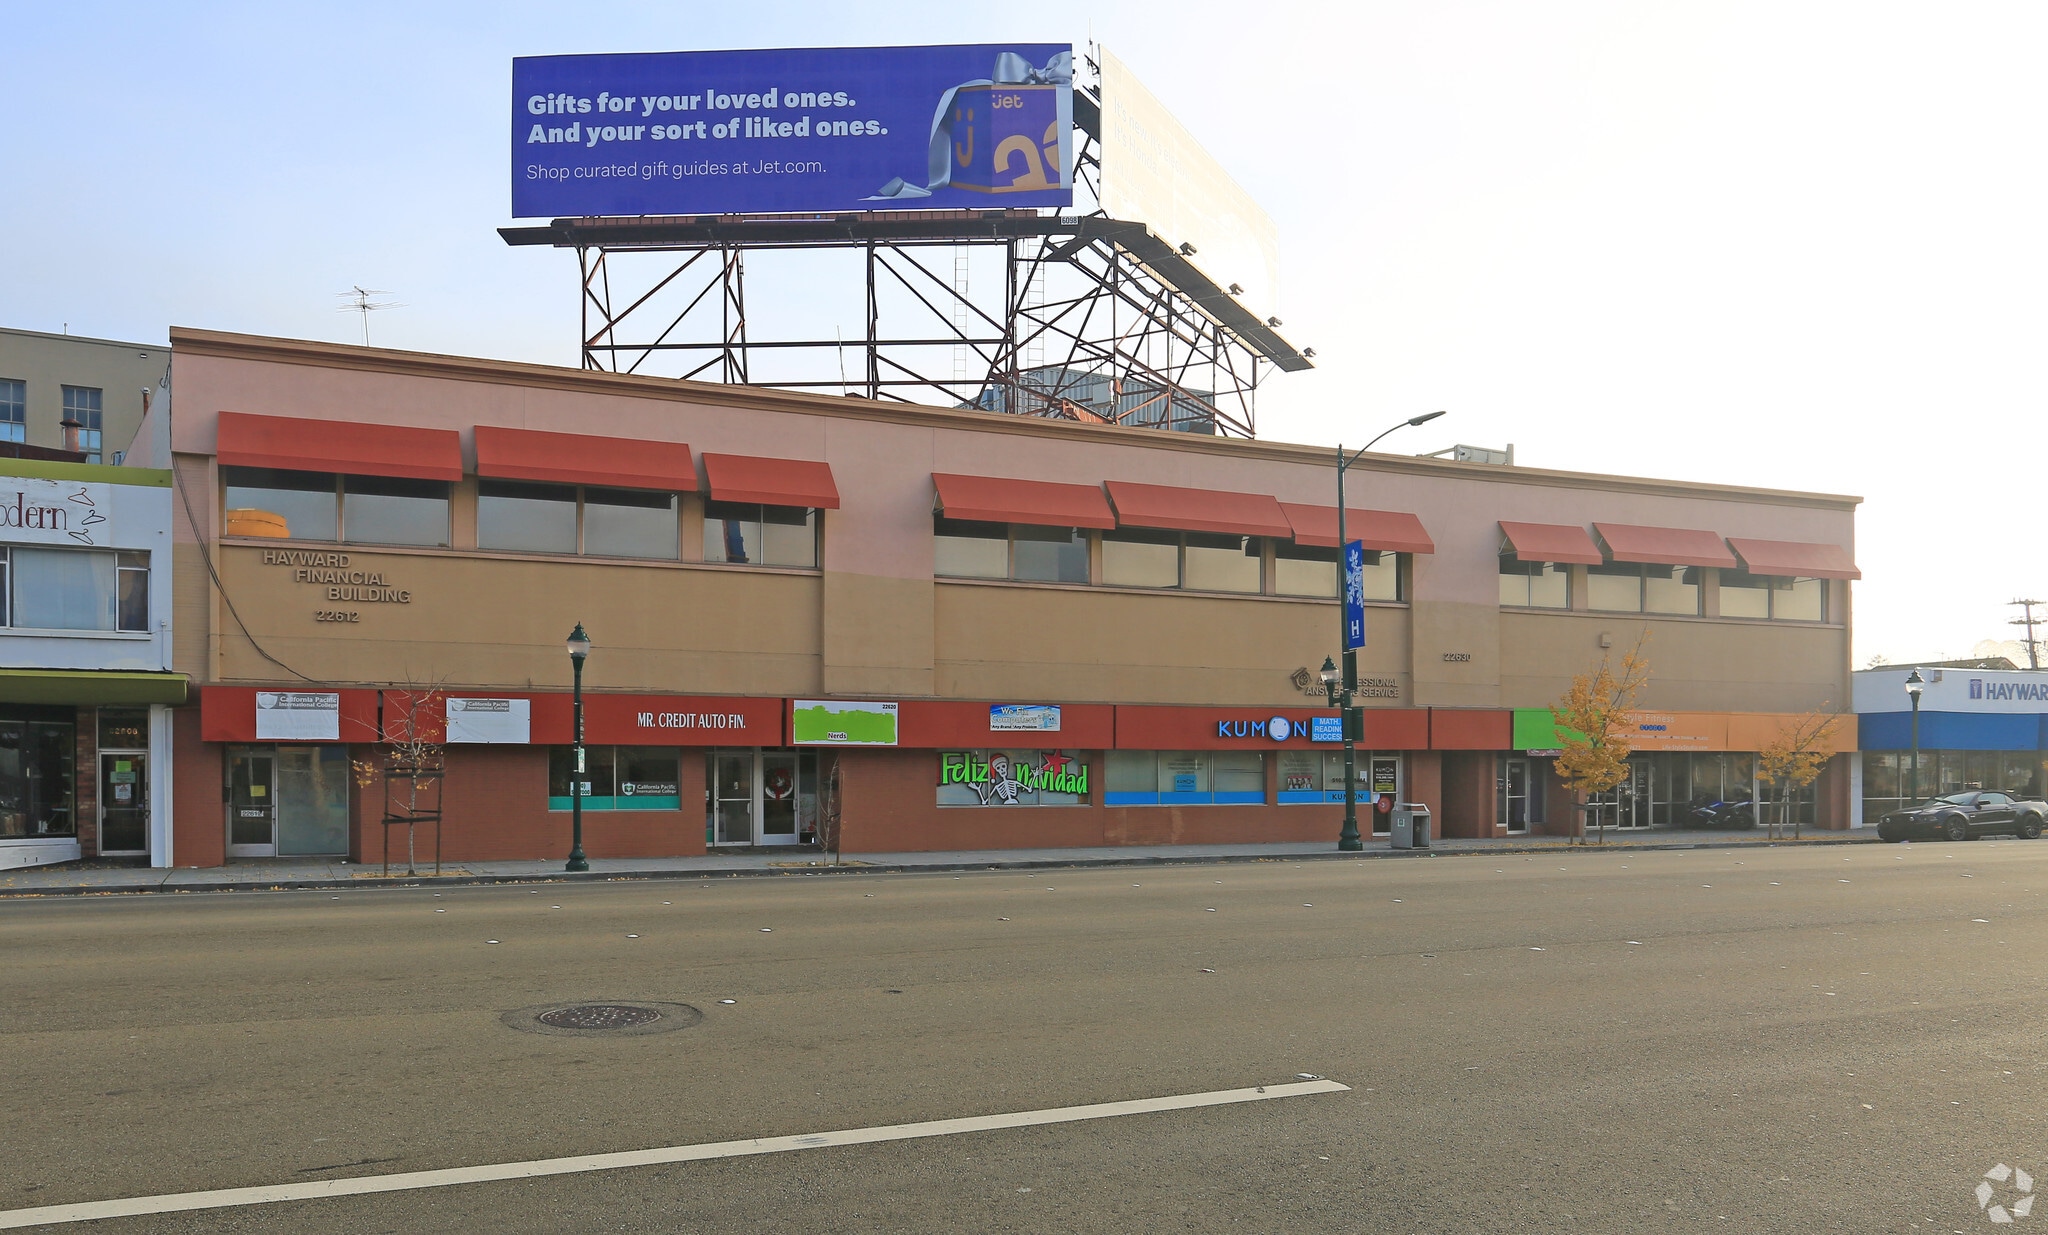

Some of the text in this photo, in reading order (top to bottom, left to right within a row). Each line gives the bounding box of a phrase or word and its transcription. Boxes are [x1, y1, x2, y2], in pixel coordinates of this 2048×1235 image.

[527, 87, 856, 117] Gifts for your loved ones.
[526, 116, 888, 148] And your sort of liked ones.
[526, 160, 827, 182] Shop curated gift guides at Jet.com.
[263, 551, 351, 568] HAYWARD
[295, 569, 391, 586] FINANCIAL
[328, 586, 411, 603] BUILDING
[316, 610, 360, 622] 22612
[1444, 653, 1471, 662] 22630
[1306, 687, 1399, 698] ANSERG SERVICE
[1986, 683, 2048, 701] HAYWAR
[992, 714, 1038, 724] Computers
[1001, 706, 1014, 715] We
[1645, 713, 1676, 723] Fitness
[637, 712, 746, 729] MR. CREDIT AUTO FIN.
[1218, 716, 1307, 742] KUMON
[942, 752, 989, 784] Feliz
